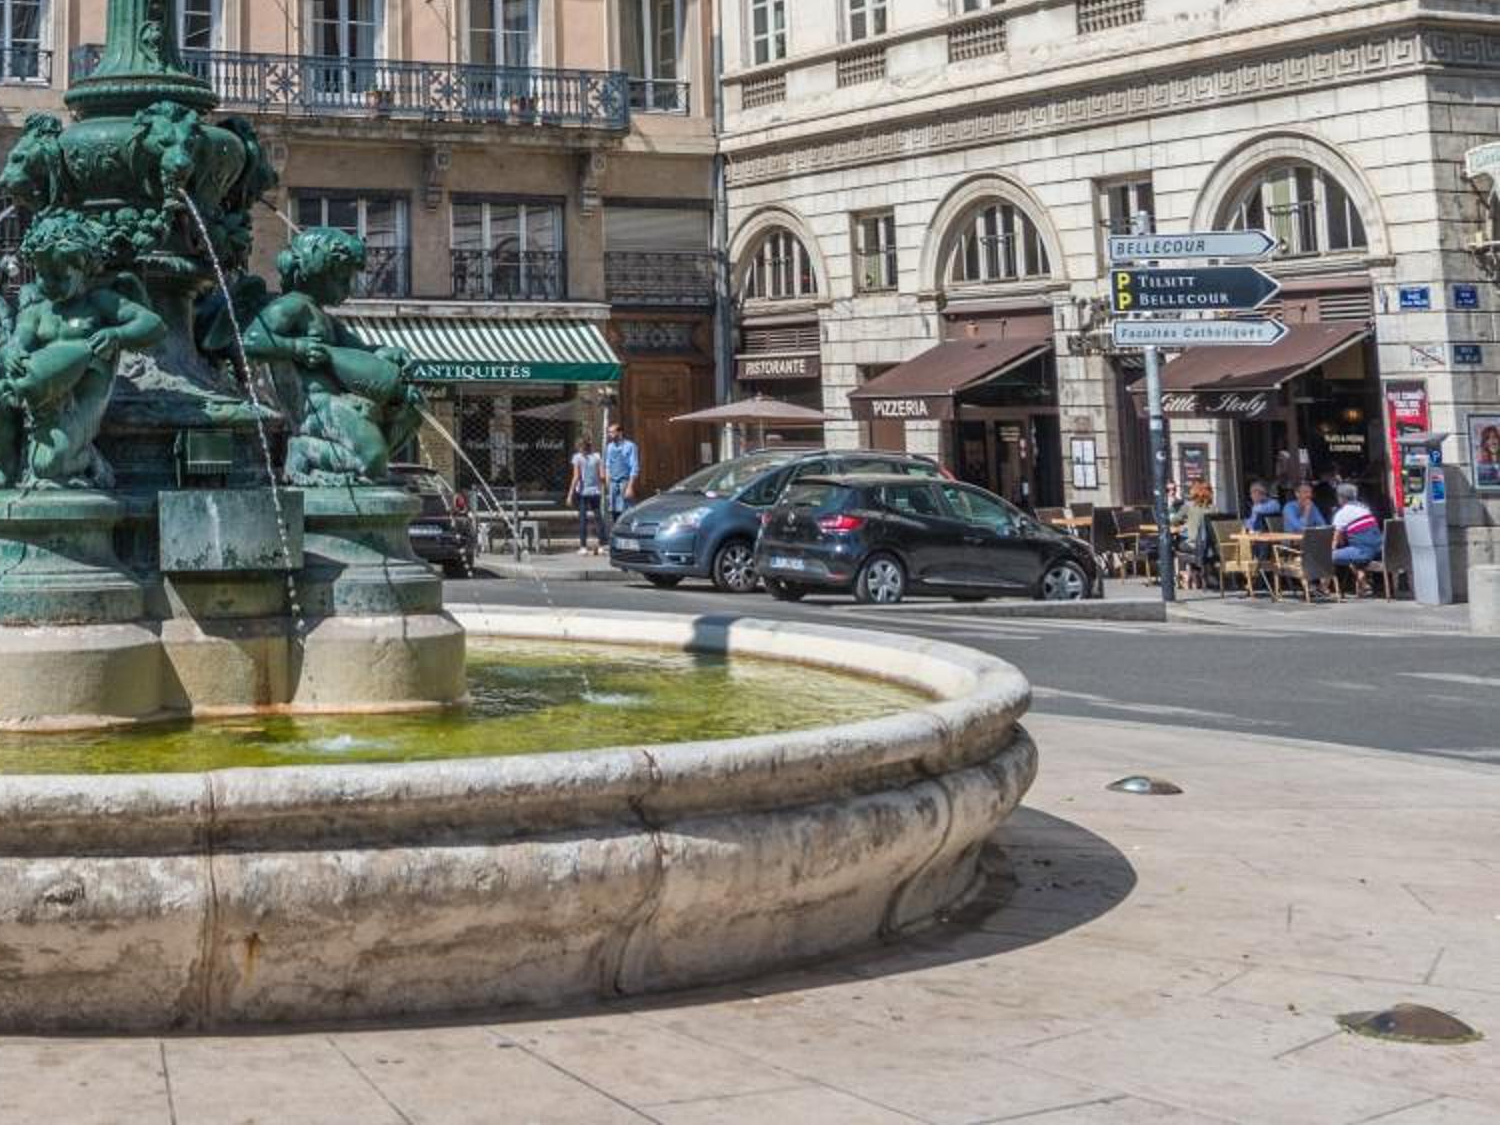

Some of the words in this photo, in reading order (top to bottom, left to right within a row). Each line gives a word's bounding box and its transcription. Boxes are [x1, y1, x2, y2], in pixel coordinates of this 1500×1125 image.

[1116, 239, 1206, 255] BELLECOUR
[1116, 272, 1132, 290] P
[1118, 292, 1133, 310] P
[1138, 292, 1230, 307] BELLECOUR
[1120, 326, 1177, 339] Facultés
[1183, 325, 1264, 341] Catholiques
[414, 363, 531, 379] ANTIQUITÉS
[745, 359, 806, 375] RISTORANTE
[871, 399, 929, 417] PIZZERIA
[1206, 391, 1268, 416] Italy
